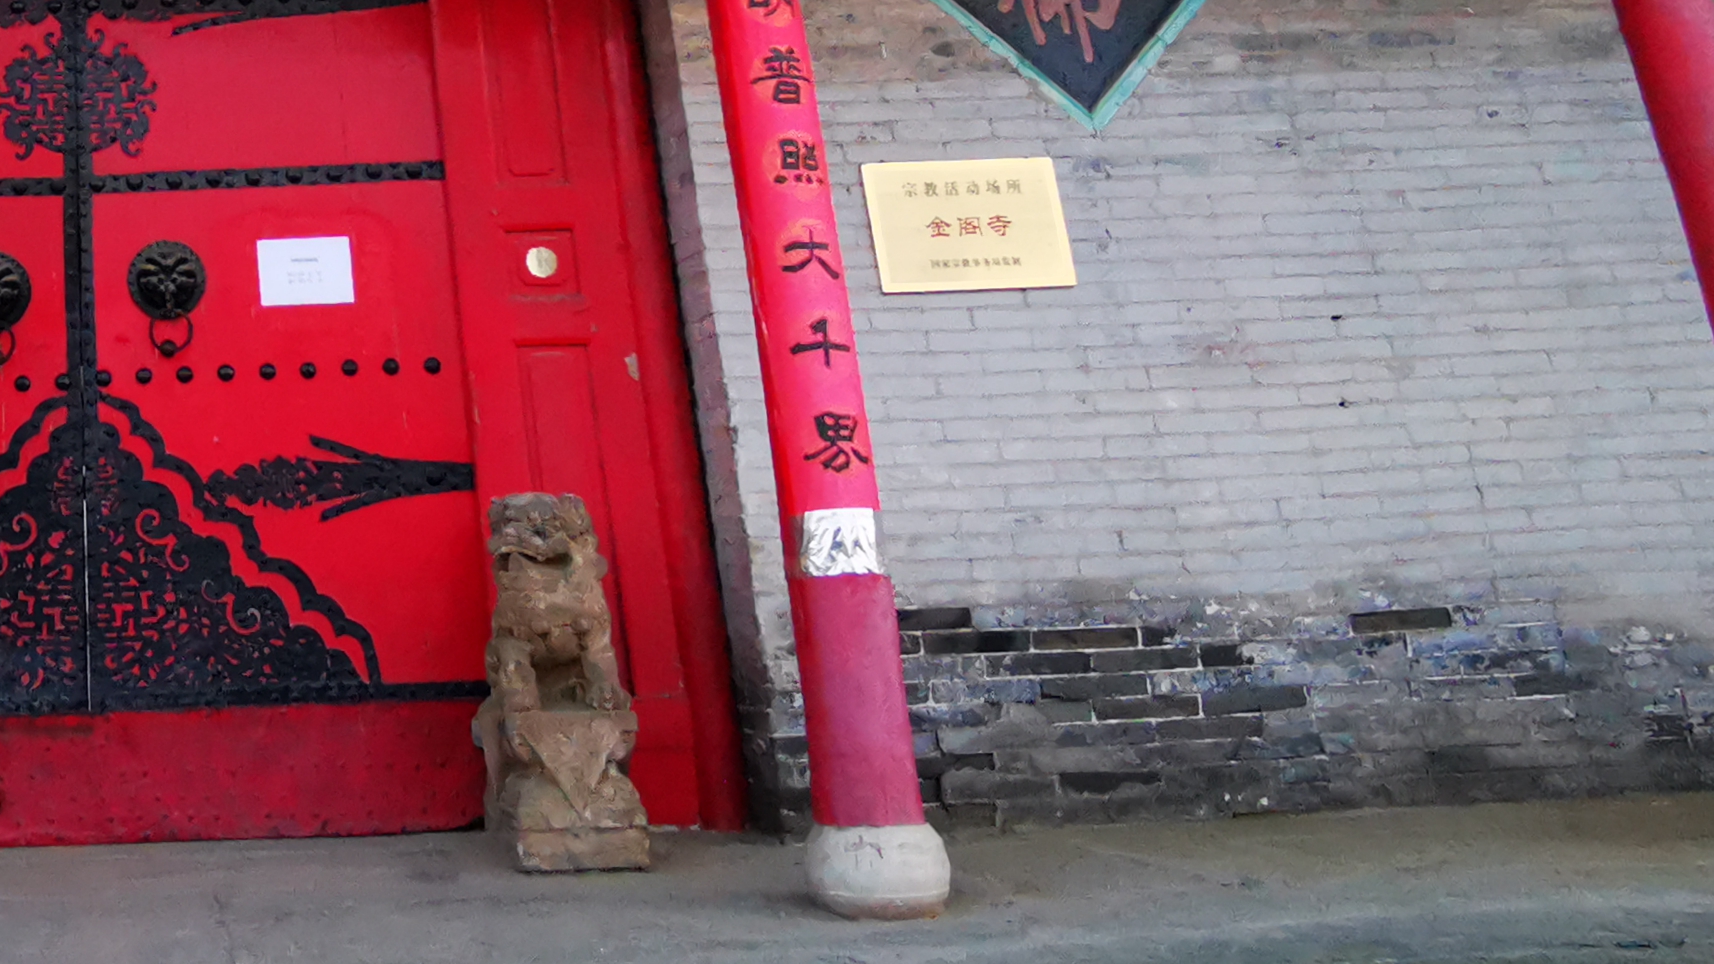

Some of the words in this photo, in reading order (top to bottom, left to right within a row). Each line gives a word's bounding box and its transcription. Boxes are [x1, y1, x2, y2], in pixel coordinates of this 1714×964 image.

[902, 179, 1022, 198] 宗教活动场所
[926, 214, 1013, 237] 金阁寺
